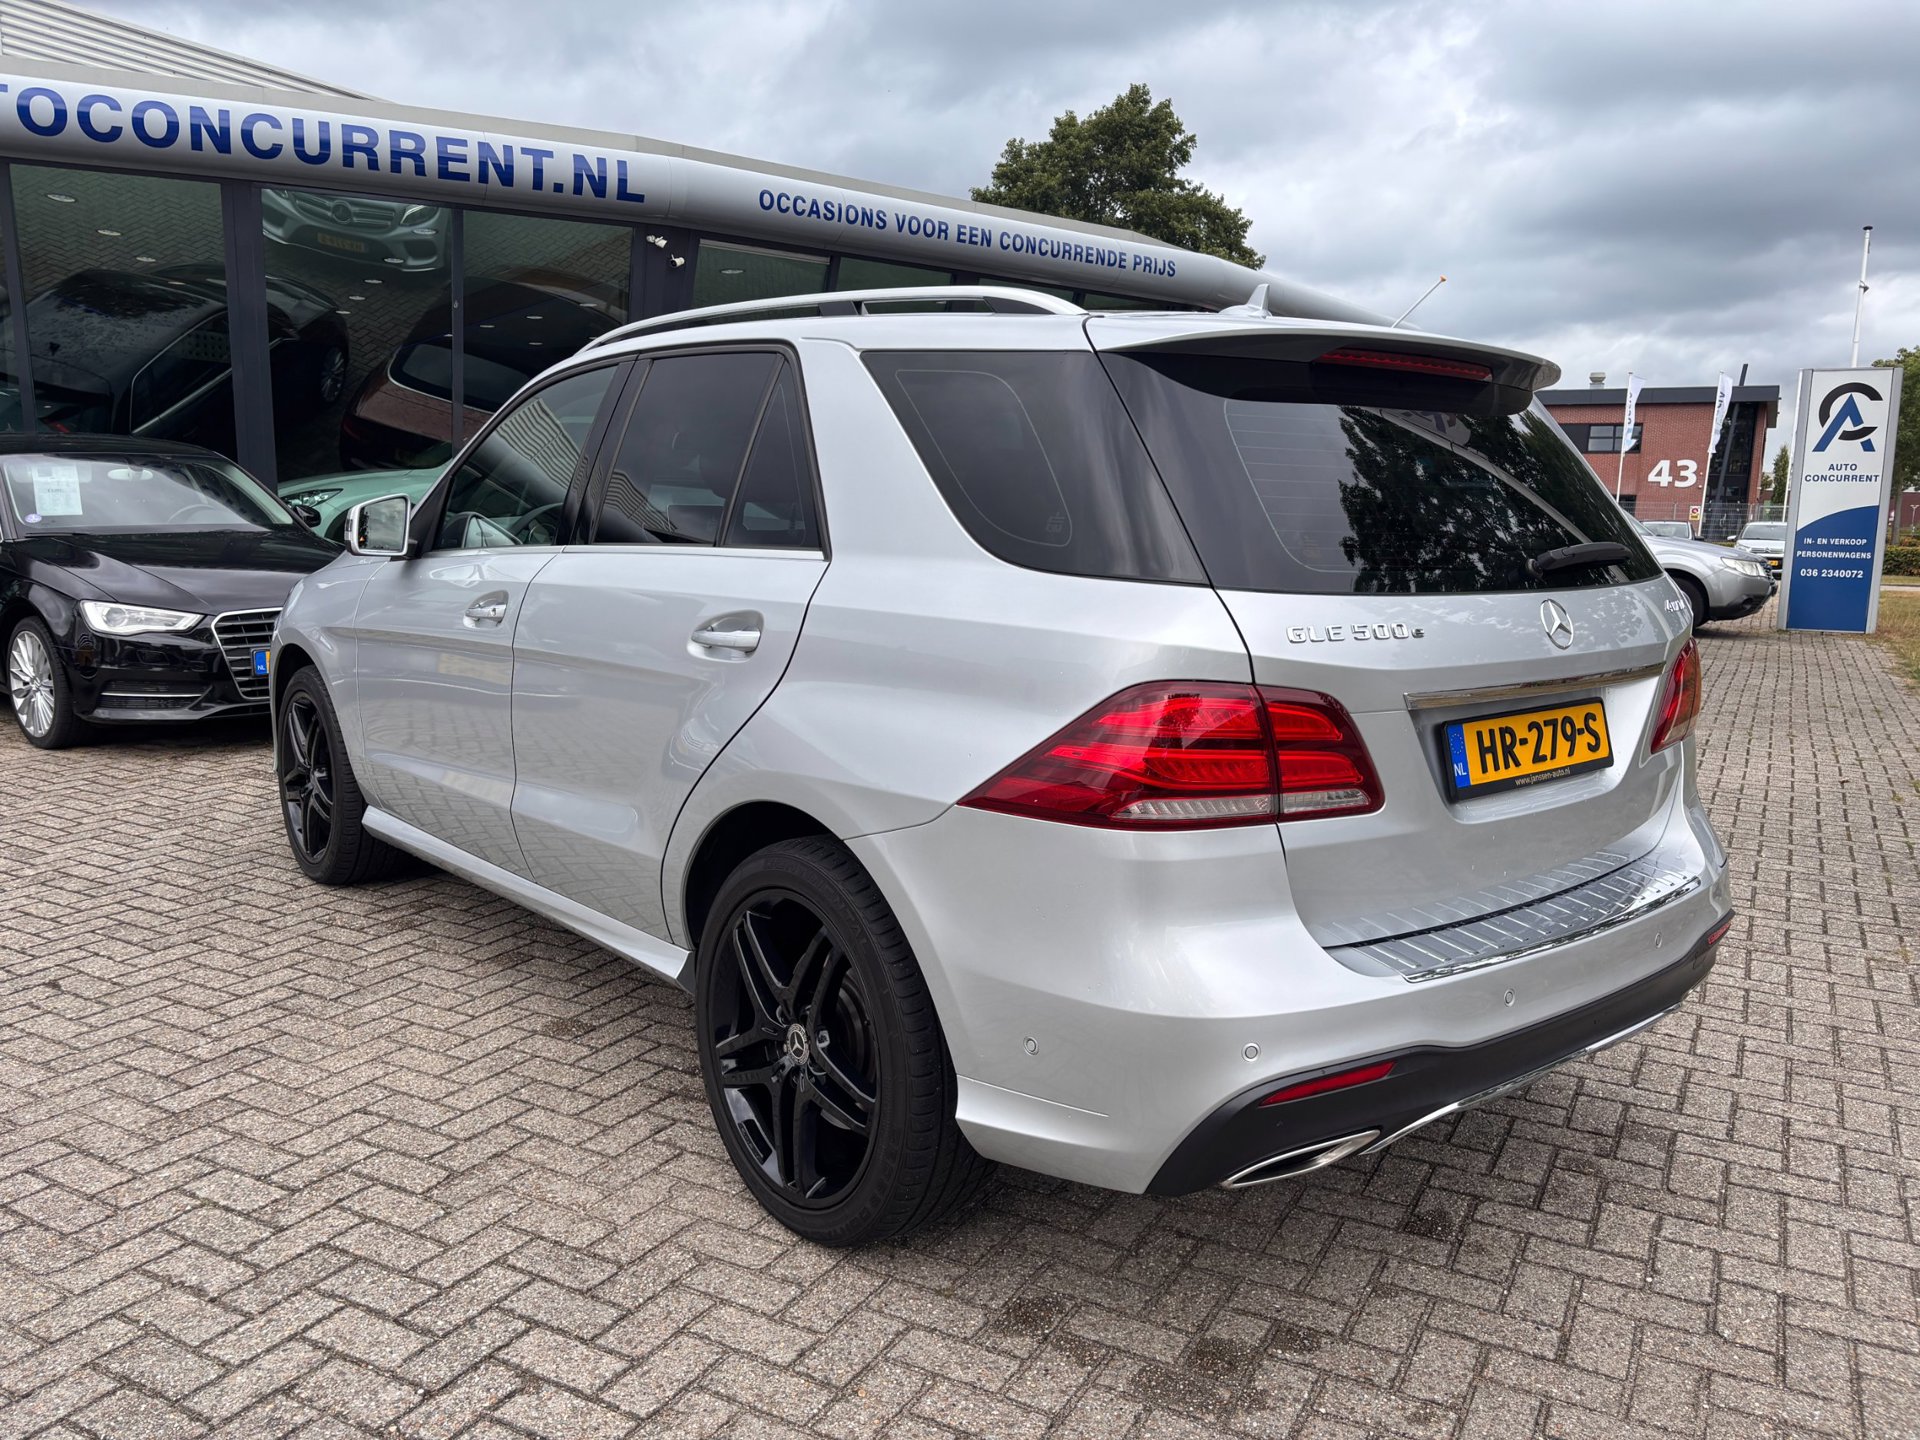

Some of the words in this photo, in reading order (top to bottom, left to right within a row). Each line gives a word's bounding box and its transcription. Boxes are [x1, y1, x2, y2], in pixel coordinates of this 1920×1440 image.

[0, 83, 645, 203] OCONCURRENT.NL
[759, 190, 887, 230] OCCASIONS
[895, 213, 949, 240] VOOR
[956, 224, 992, 247] EEN
[1000, 231, 1127, 269] CONCURRENDE
[1133, 254, 1176, 277] PRIJS
[1647, 459, 1697, 488] 43
[1828, 463, 1858, 471] AUTO
[1804, 474, 1880, 483] CONCURRENT
[1803, 537, 1815, 545] IN-
[1816, 537, 1828, 545] EN
[1829, 538, 1867, 546] VERKOOP
[1796, 551, 1872, 560] PERSONENWAGENS
[1800, 568, 1818, 577] 036
[1821, 568, 1864, 578] 2340072
[1286, 624, 1345, 643] GLE
[1476, 712, 1601, 774] HR-279-S
[1454, 763, 1467, 777] NL
[1514, 767, 1571, 786] www.janssen-auto.nl
